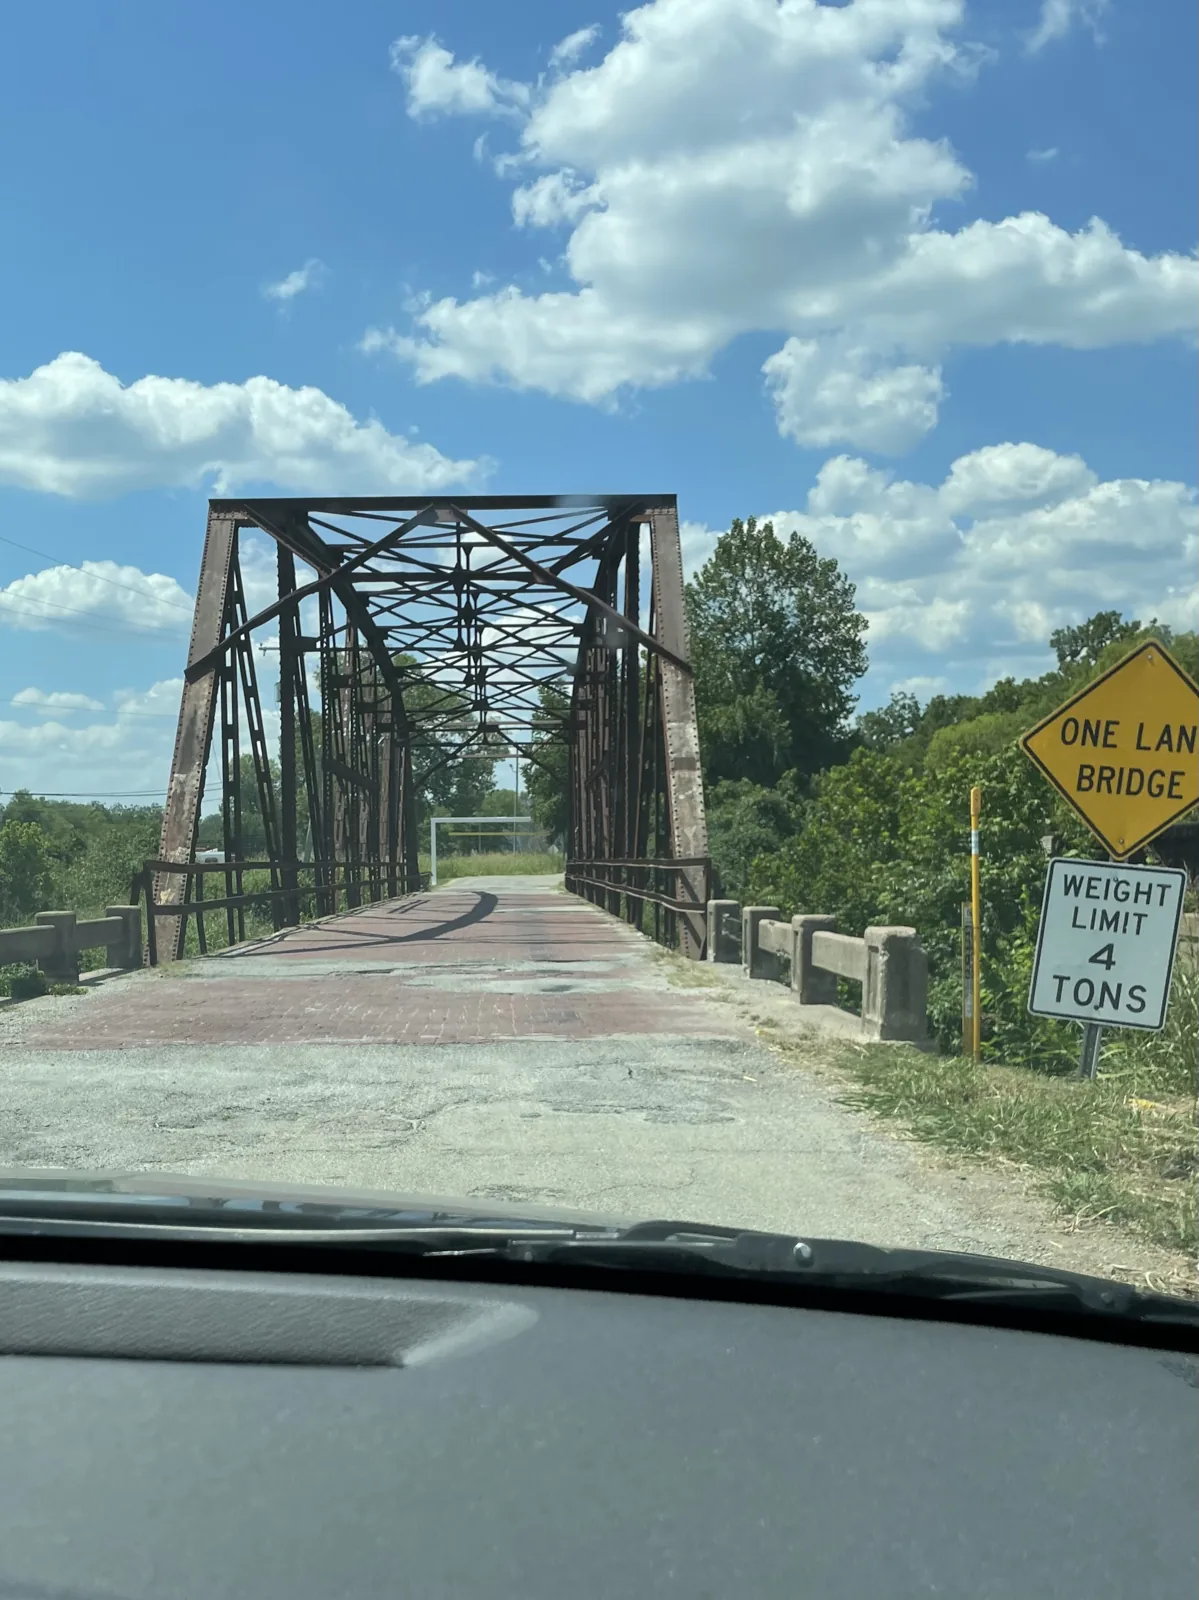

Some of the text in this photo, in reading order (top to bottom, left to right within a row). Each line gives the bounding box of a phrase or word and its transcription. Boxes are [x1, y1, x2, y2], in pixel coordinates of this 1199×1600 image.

[1061, 717, 1198, 754] ONE LAN
[1076, 764, 1186, 800] BRIDGE
[1063, 874, 1172, 907] WEIGHT
[1072, 906, 1148, 936] LIMIT
[1088, 943, 1116, 971] 4
[1053, 974, 1147, 1013] TONS
